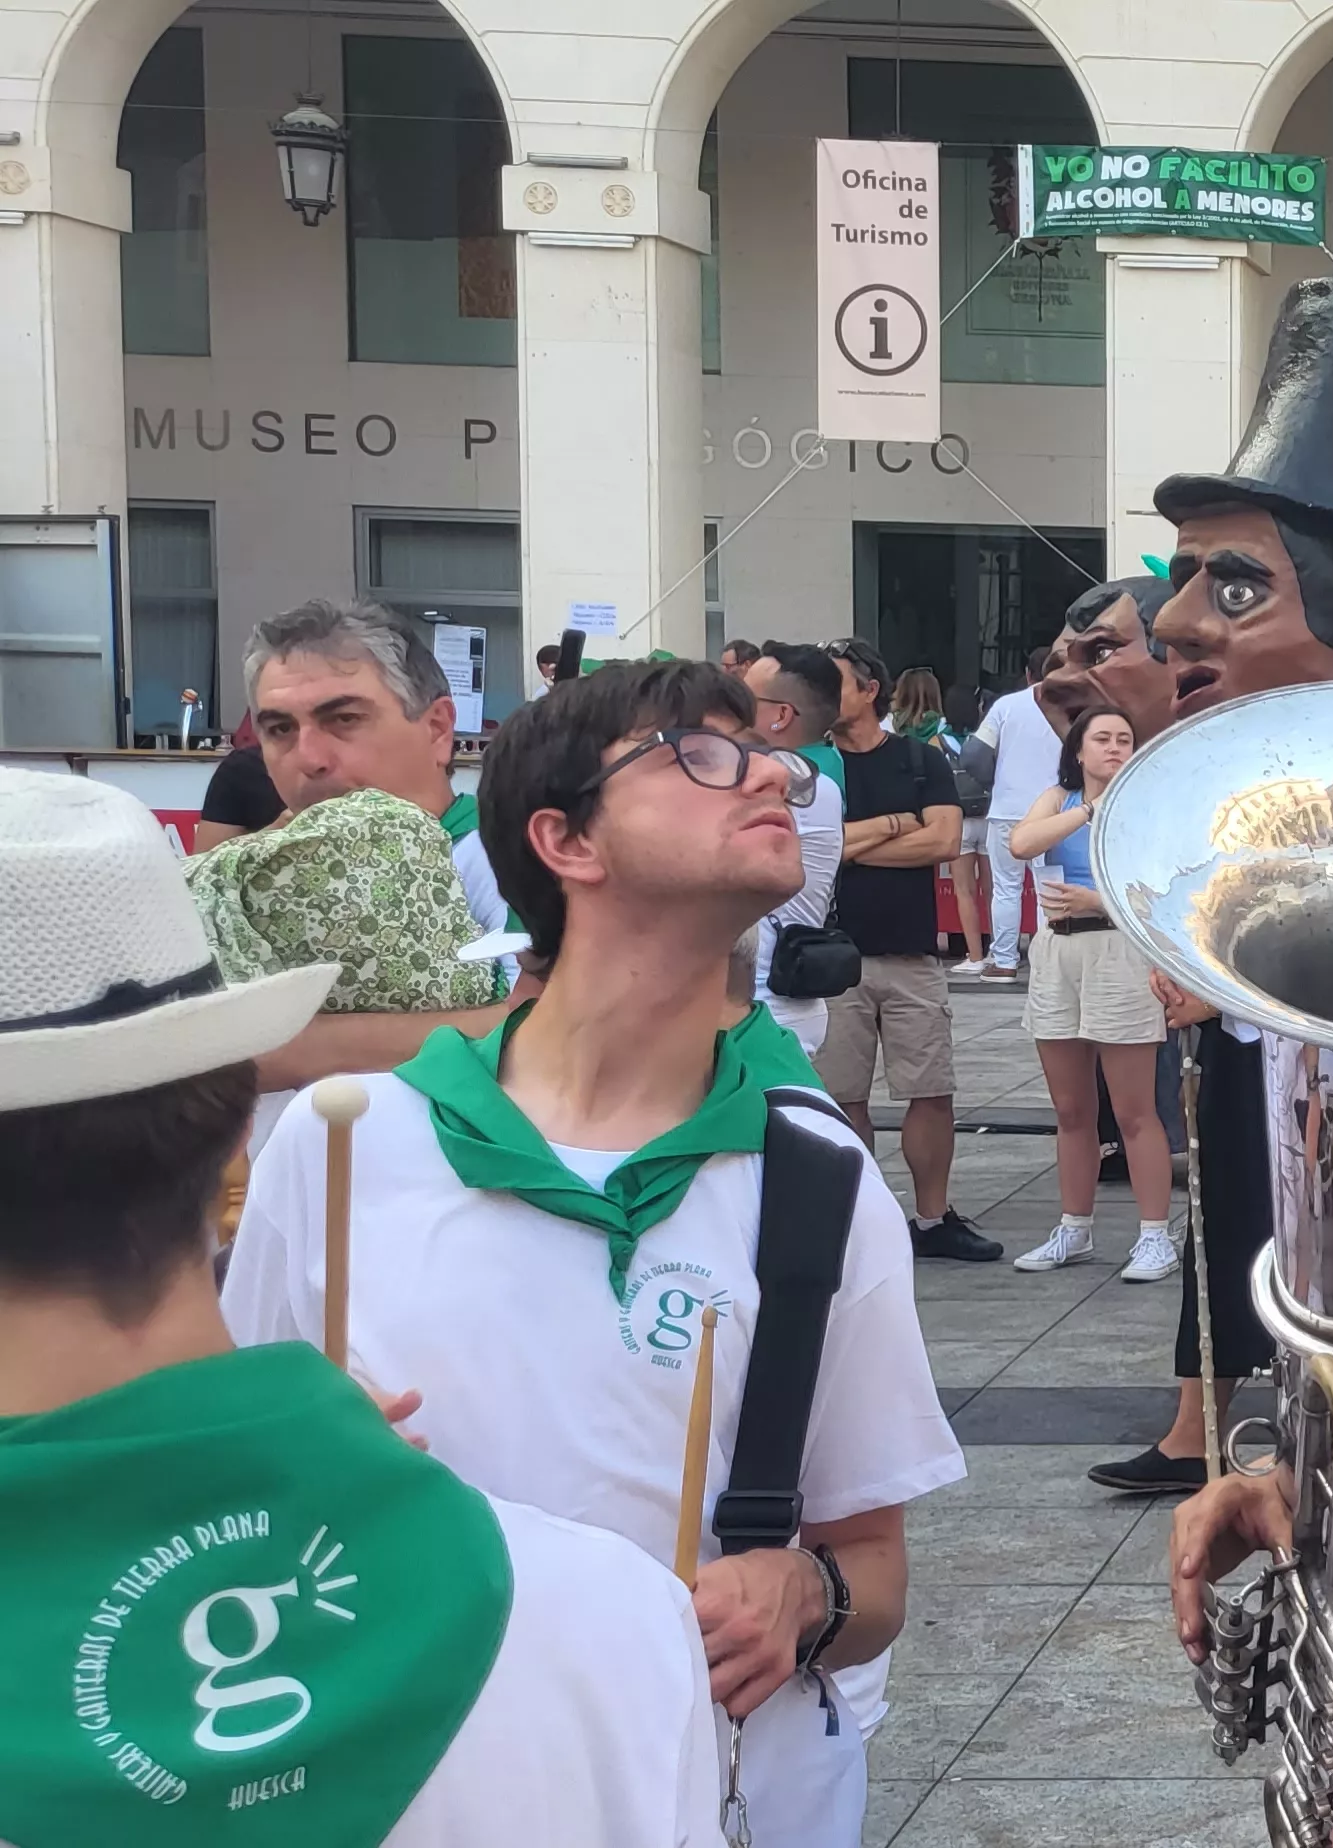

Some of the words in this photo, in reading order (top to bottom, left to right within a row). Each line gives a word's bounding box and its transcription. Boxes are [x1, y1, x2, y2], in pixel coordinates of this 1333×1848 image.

[841, 169, 928, 193] Oficina
[1044, 155, 1094, 183] YO
[1100, 154, 1150, 180] NO
[1159, 157, 1316, 193] FACILITO
[898, 199, 929, 220] de
[1046, 186, 1168, 212] ALCOHOL
[1174, 189, 1192, 210] A
[1197, 190, 1316, 222] MENORES
[831, 223, 929, 246] Turismo
[132, 406, 398, 458] MUSEO
[650, 1262, 682, 1278] TIERRA
[684, 1262, 713, 1279] PLANA
[646, 1288, 705, 1351] g
[650, 1354, 683, 1371] HUESCA
[193, 1509, 271, 1552] PLANA
[111, 1534, 196, 1601] TIERRA
[90, 1597, 132, 1630] DE
[74, 1632, 117, 1730] GAITERAS
[182, 1575, 312, 1752] g
[226, 1765, 308, 1812] HUESCA
